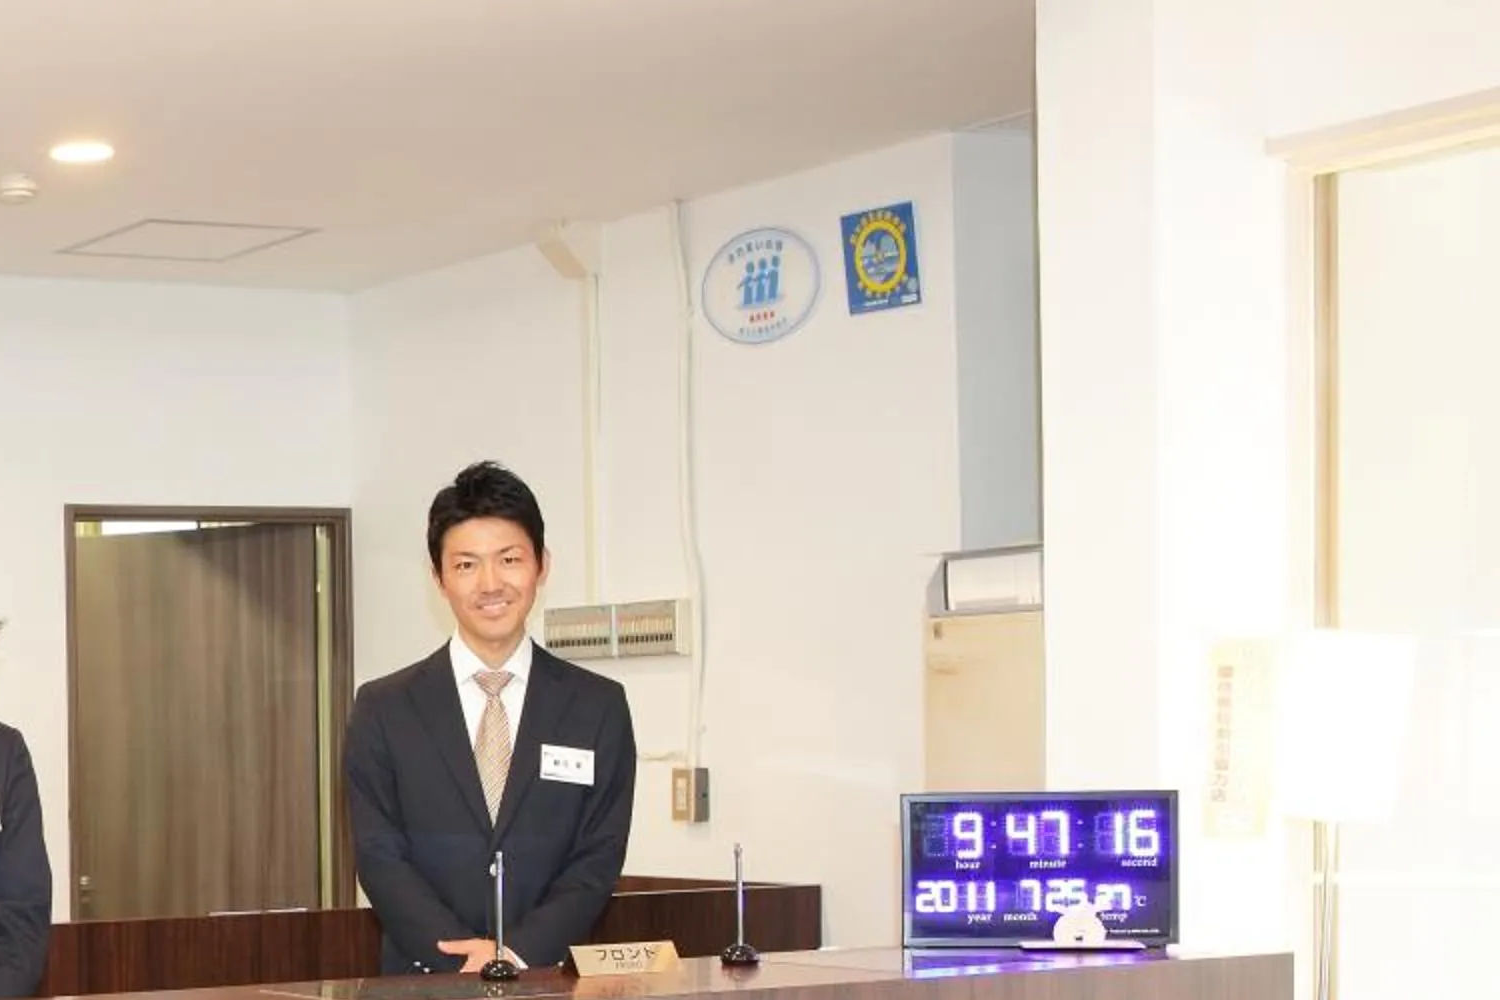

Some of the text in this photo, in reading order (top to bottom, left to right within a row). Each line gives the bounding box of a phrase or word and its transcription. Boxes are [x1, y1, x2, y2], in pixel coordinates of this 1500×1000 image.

[955, 860, 981, 869] hour
[1029, 859, 1067, 869] minute
[1121, 857, 1158, 867] second
[915, 879, 996, 912] 2011
[967, 912, 992, 924] year
[595, 947, 656, 960] フロント
